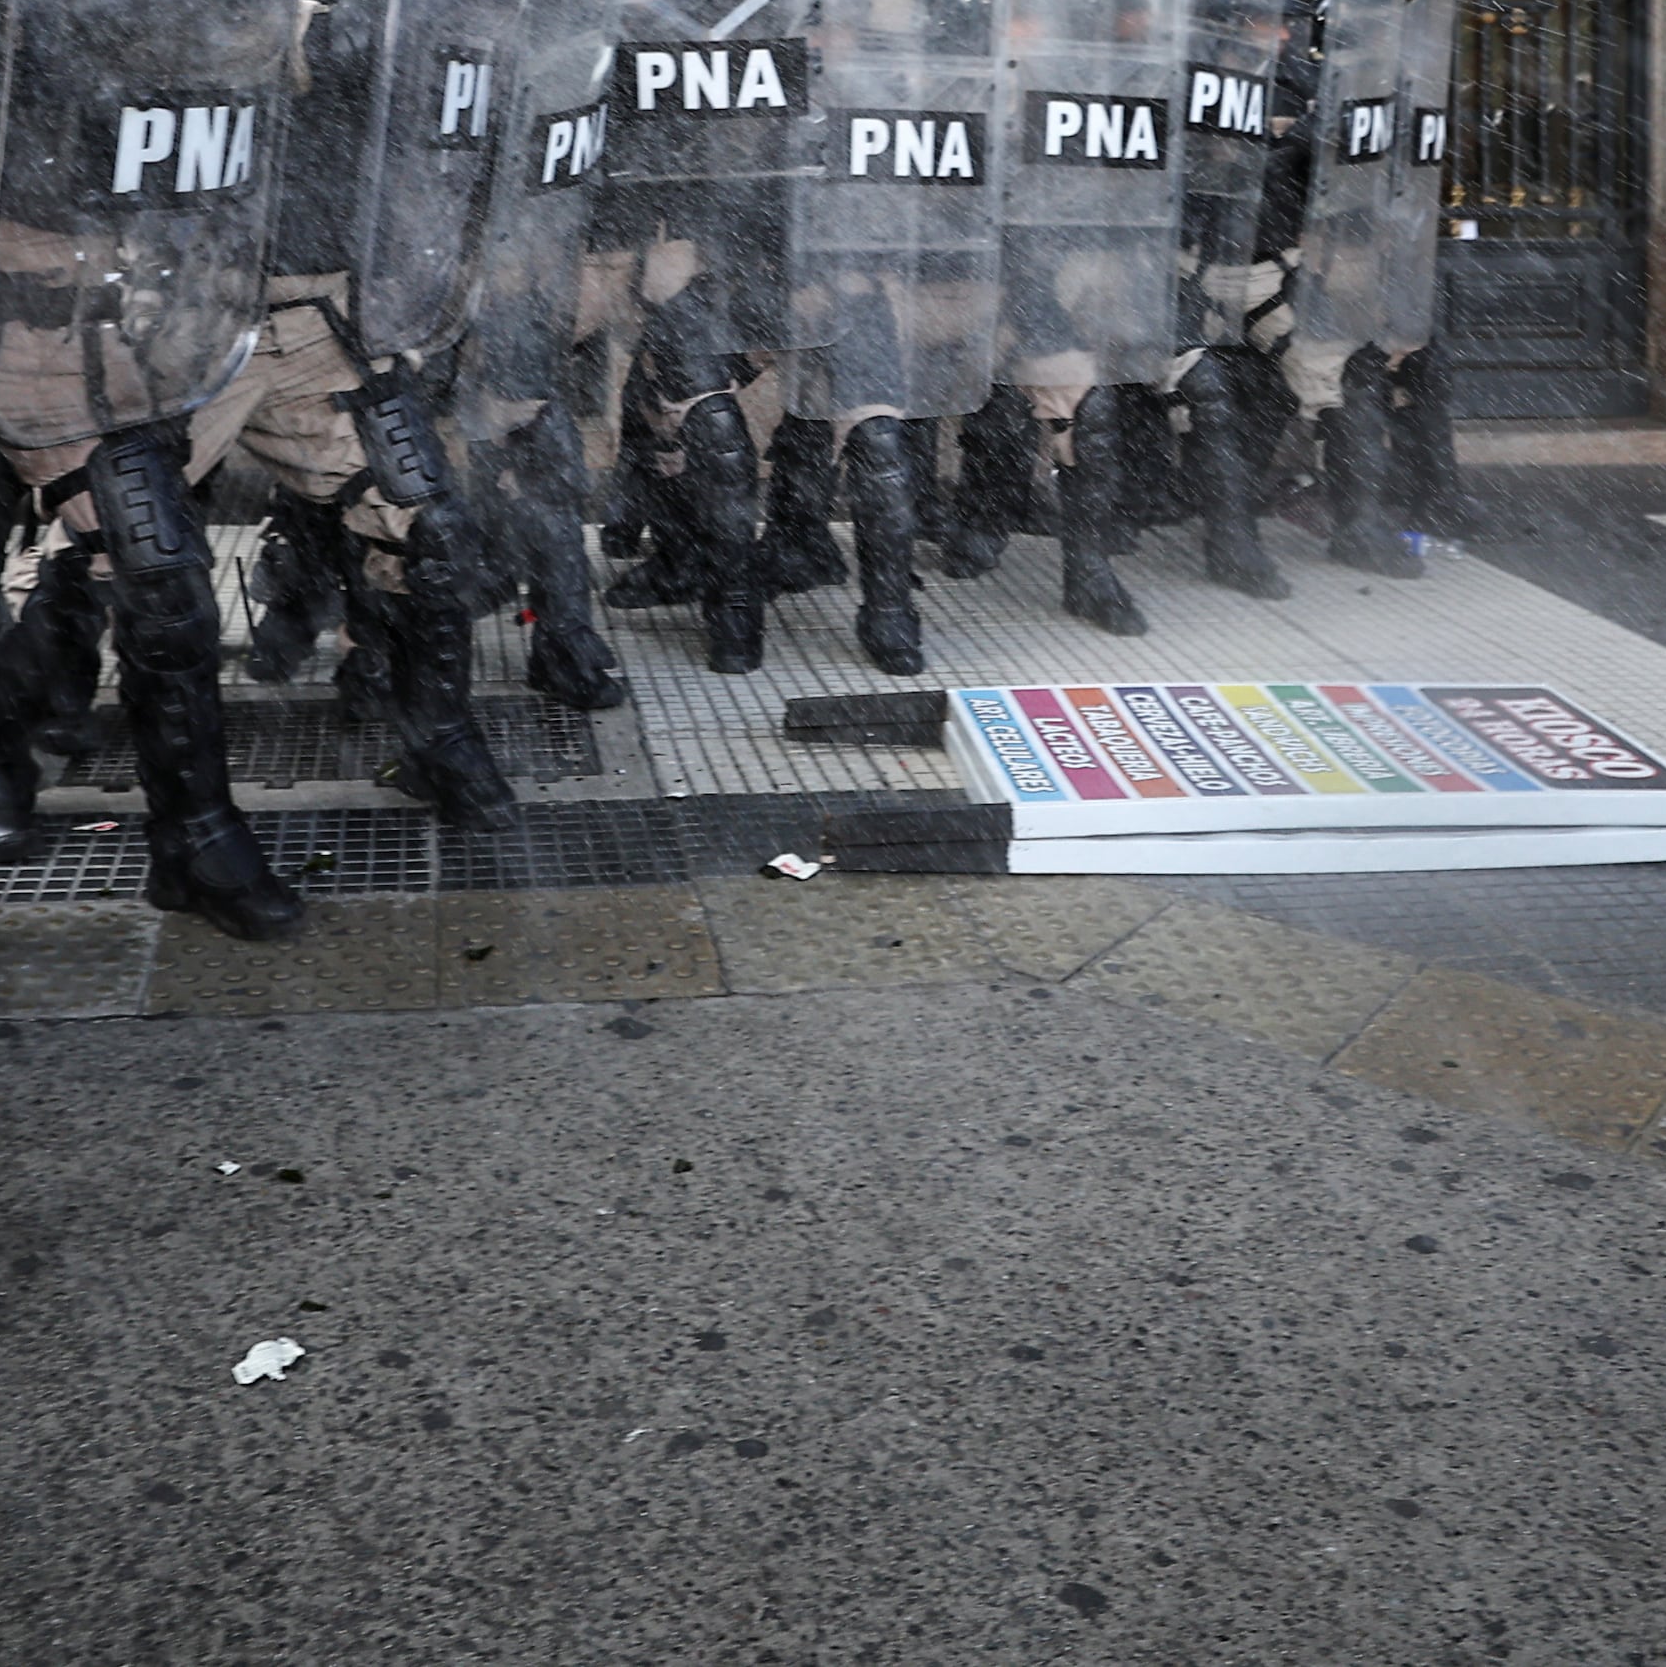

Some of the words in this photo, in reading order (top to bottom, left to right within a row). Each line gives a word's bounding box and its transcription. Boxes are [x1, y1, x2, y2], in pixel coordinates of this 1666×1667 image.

[635, 48, 788, 110] PNA
[1188, 71, 1264, 136] PNA
[111, 105, 255, 193] PNA
[850, 117, 973, 178] PNA
[1044, 100, 1159, 161] PNA
[967, 698, 1010, 724] ART.
[1032, 717, 1098, 770] LACTEOS
[1078, 705, 1165, 782] TABAQUERIA
[1123, 693, 1233, 791] CERVEZAS-HIELO
[1178, 696, 1290, 786] CAFE-PANCHOS
[1241, 706, 1333, 774] SANDWICHS
[1288, 700, 1322, 725] ART.
[1320, 726, 1395, 780] LIBRERIA
[1340, 702, 1453, 776] IMPRESIONES
[1393, 704, 1505, 775] FOTOCOPIAS
[1494, 697, 1656, 779] KIOSCO
[984, 725, 1059, 793] CELULARES
[1475, 718, 1592, 780] HORAS
